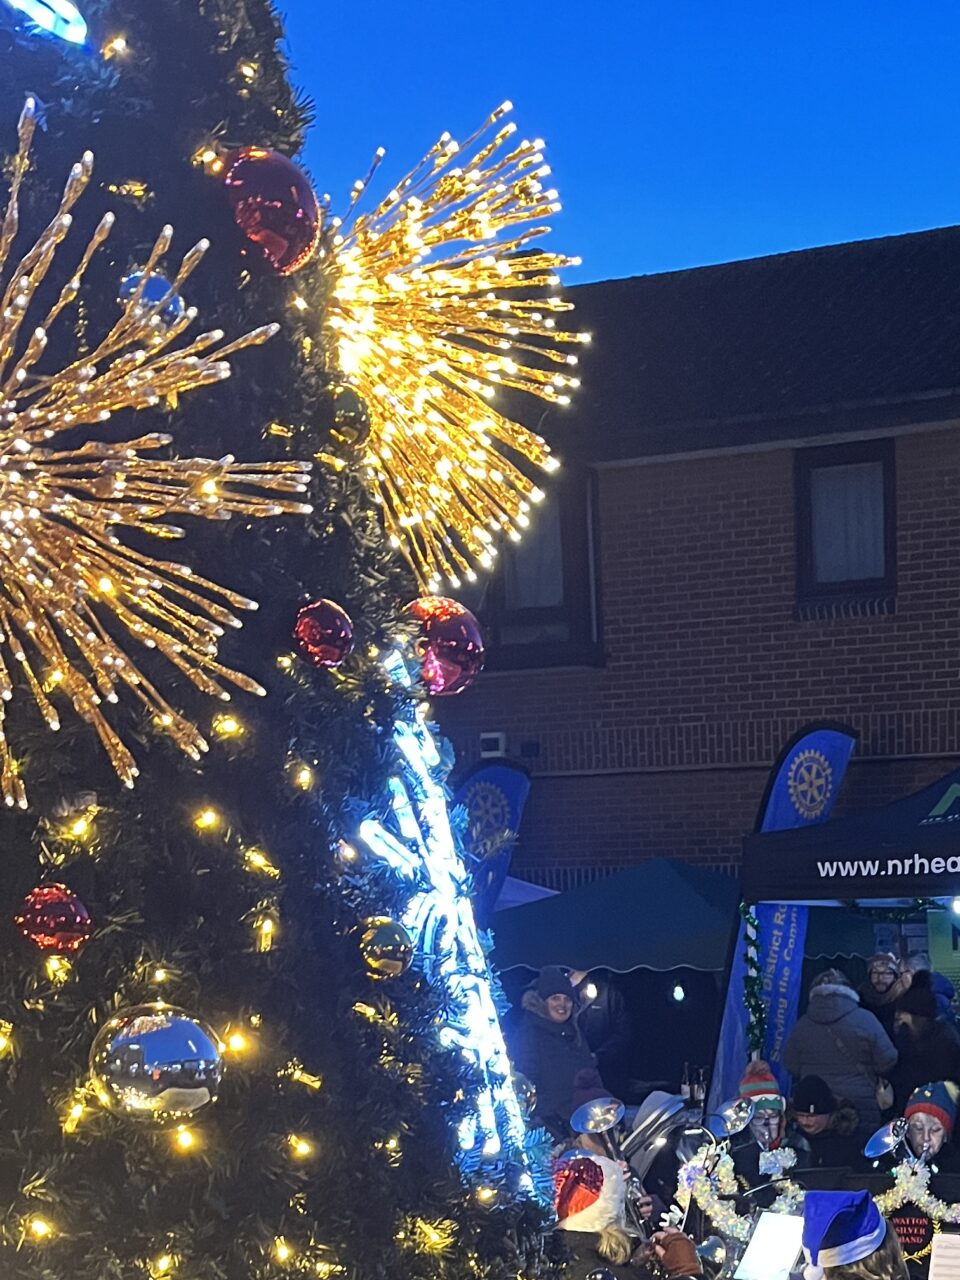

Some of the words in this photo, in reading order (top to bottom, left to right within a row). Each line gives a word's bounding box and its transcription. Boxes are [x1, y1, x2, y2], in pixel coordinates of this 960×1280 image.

[763, 929, 783, 991] District
[778, 966, 791, 992] the
[769, 998, 788, 1062] Serving
[892, 1217, 929, 1225] WATTON
[895, 1226, 926, 1235] SILVER
